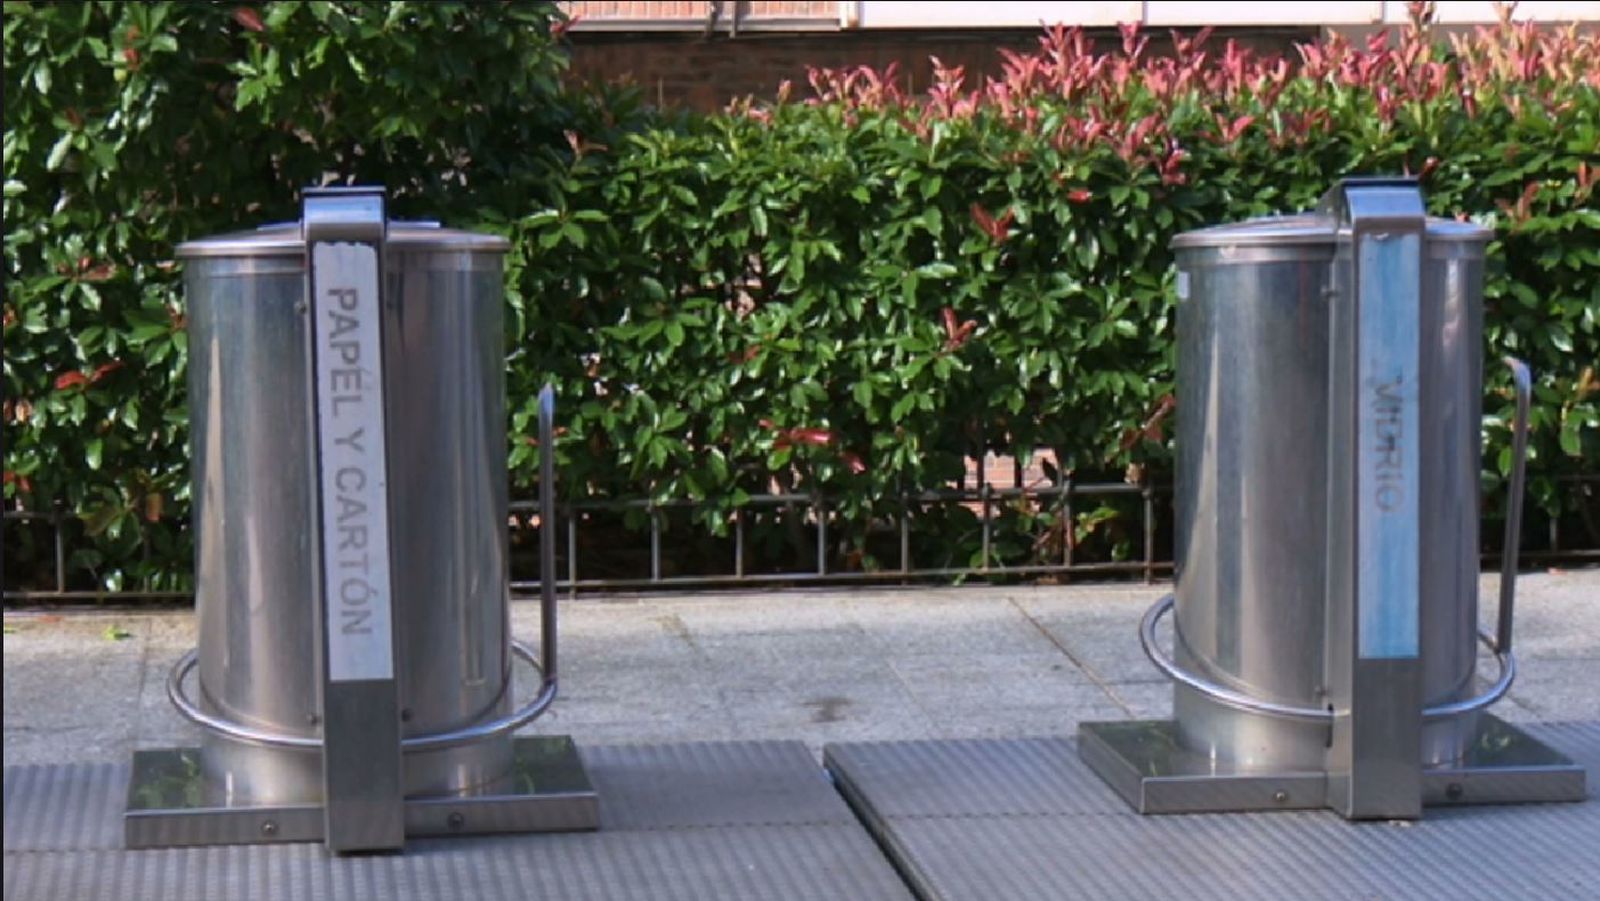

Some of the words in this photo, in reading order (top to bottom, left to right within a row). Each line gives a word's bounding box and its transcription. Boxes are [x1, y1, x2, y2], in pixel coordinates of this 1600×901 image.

[327, 287, 362, 418] PAPEL
[333, 426, 366, 453] Y
[334, 466, 379, 635] CARTÓN
